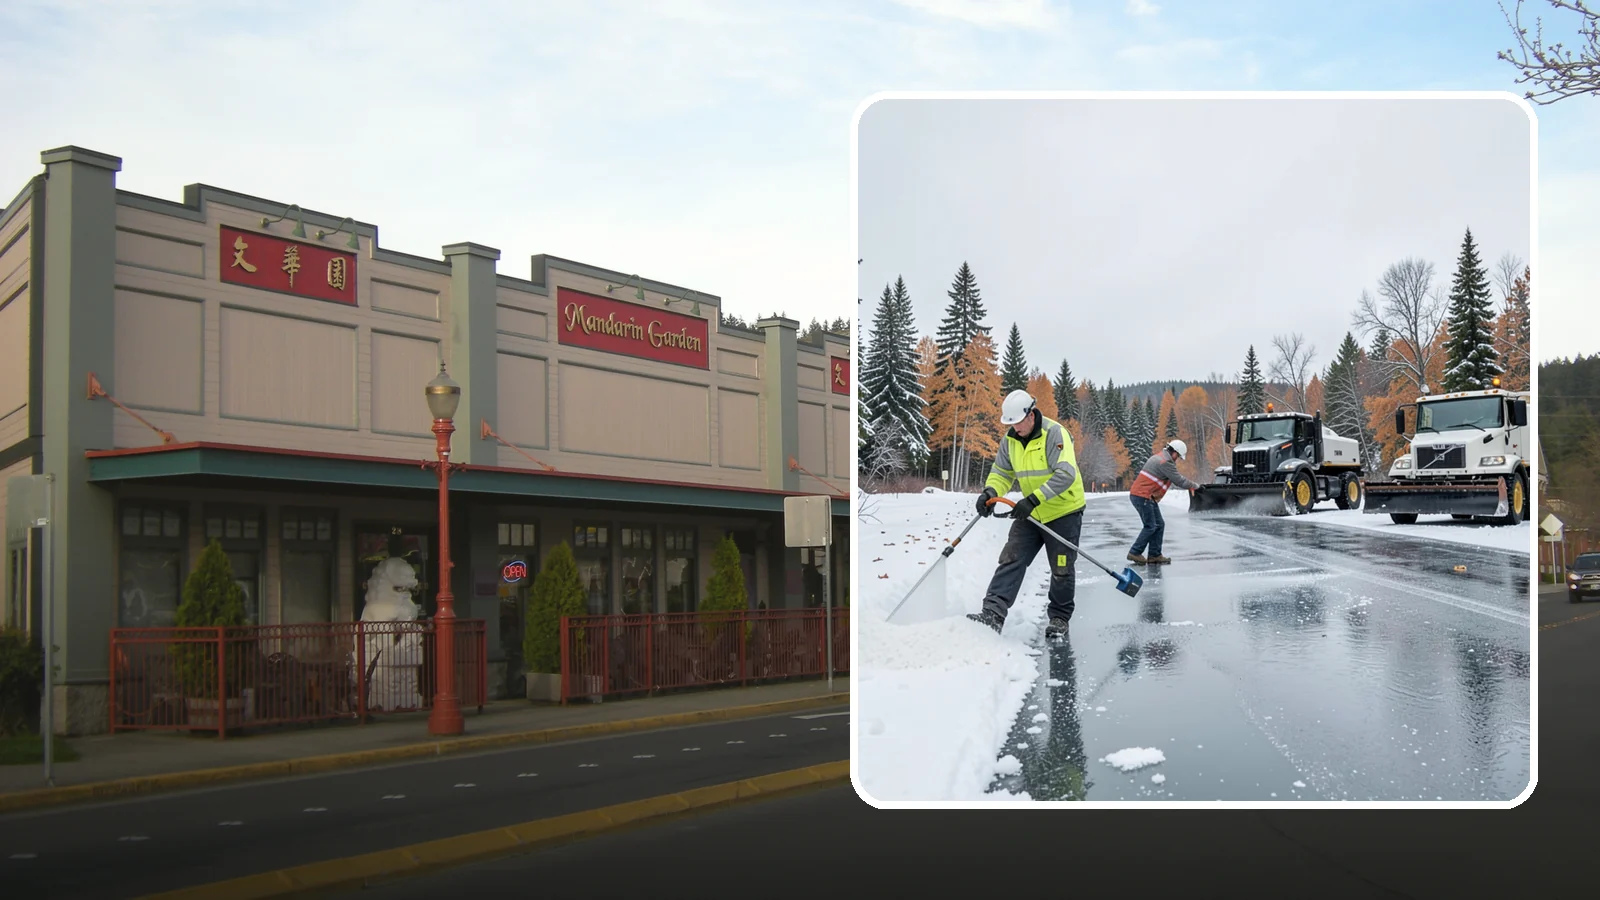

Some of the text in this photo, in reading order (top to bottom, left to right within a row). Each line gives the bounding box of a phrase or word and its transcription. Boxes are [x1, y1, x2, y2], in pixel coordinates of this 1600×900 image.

[231, 236, 346, 291] 文華園
[564, 302, 701, 352] Mandarin Garden
[503, 565, 527, 578] OPEN
